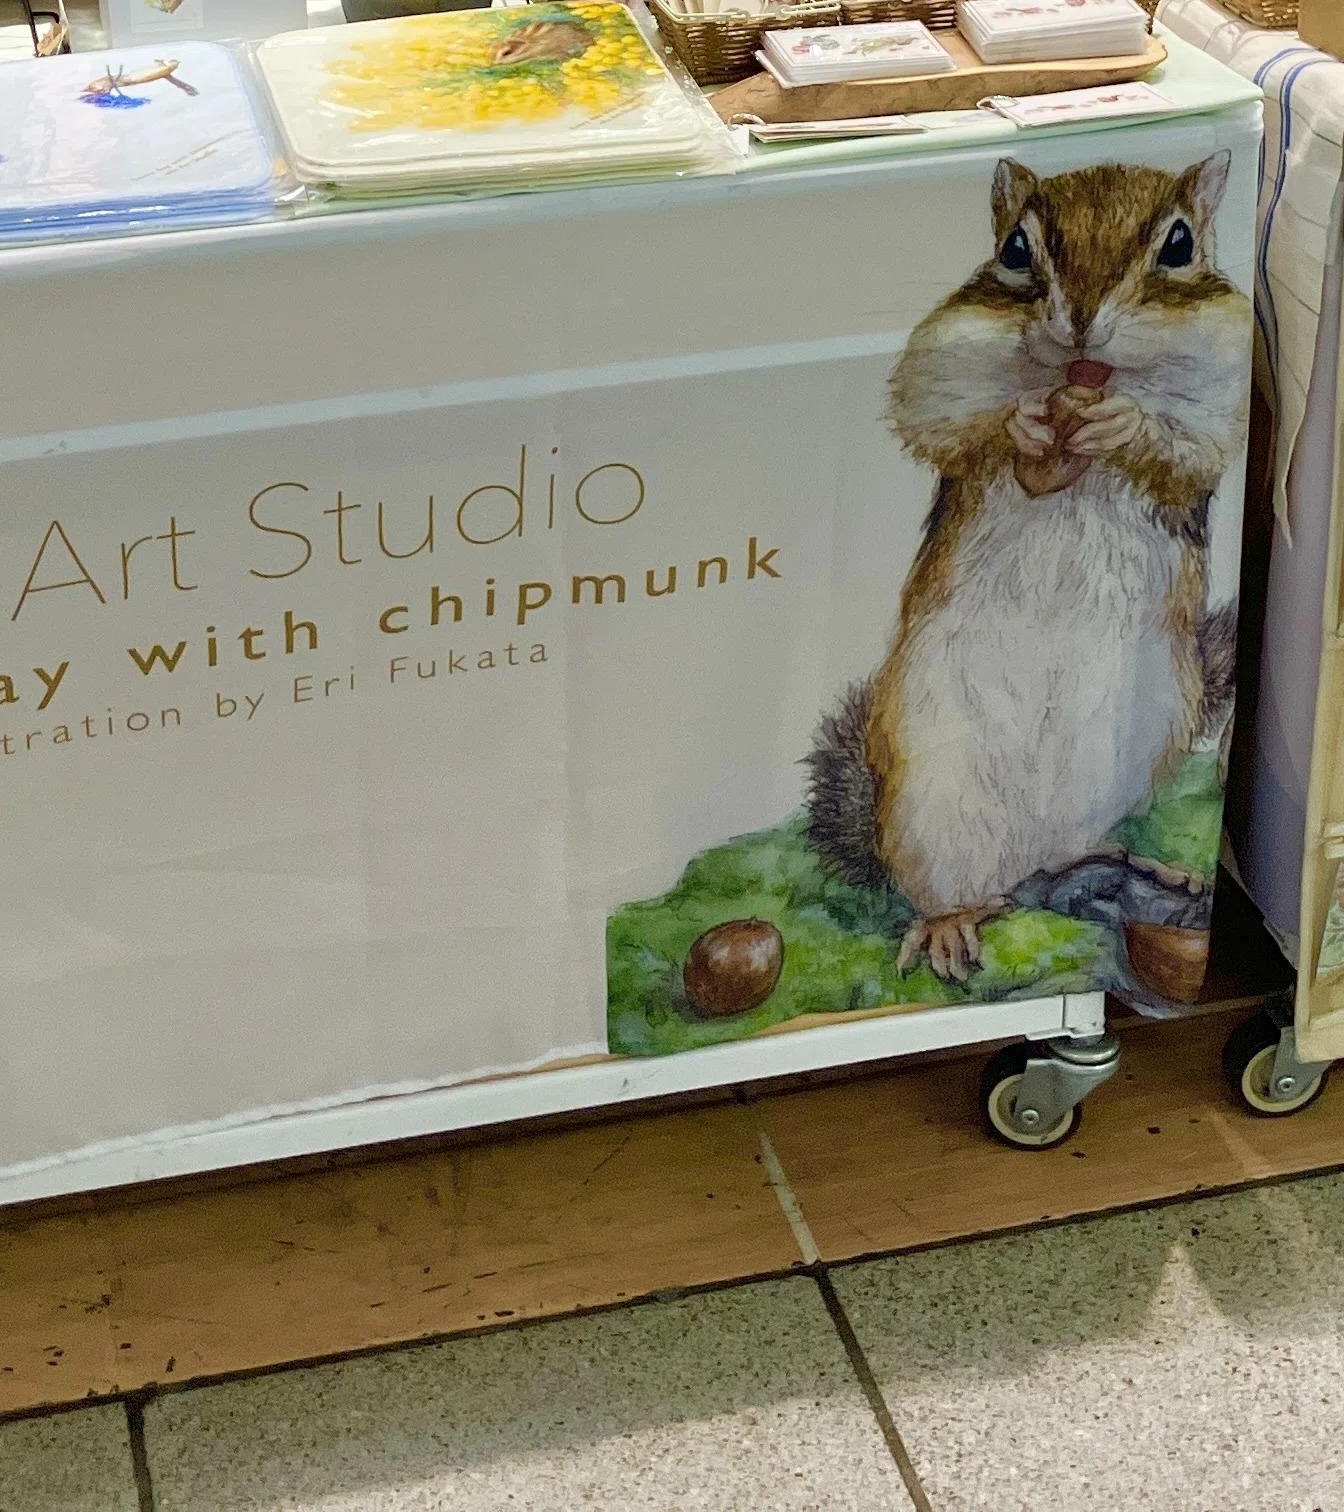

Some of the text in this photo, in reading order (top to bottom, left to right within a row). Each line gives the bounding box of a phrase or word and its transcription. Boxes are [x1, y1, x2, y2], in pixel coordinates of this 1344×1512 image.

[9, 517, 199, 623] Art
[248, 444, 646, 581] Studio
[126, 611, 321, 678] with
[378, 536, 786, 638] chipmunk
[215, 687, 265, 724] by
[291, 666, 359, 706] Eri
[388, 639, 550, 686] Fukata
